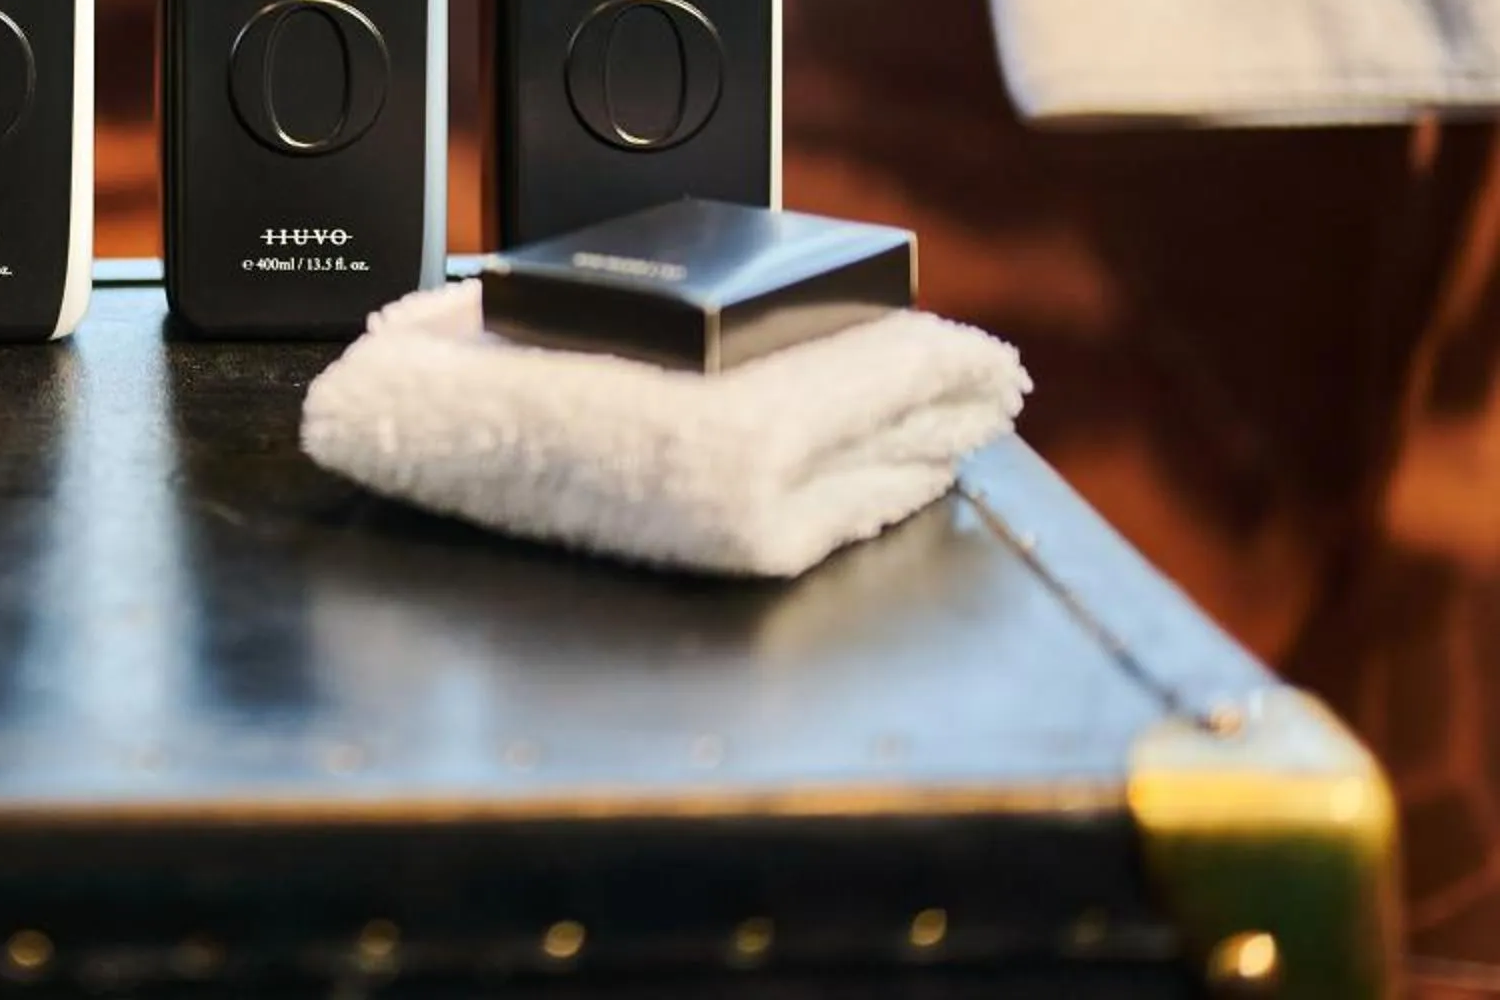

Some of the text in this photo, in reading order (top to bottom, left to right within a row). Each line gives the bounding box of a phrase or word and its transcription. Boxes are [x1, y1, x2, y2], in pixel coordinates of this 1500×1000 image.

[256, 257, 295, 270] 400ml
[307, 258, 332, 270] 13.5
[350, 261, 370, 270] oz.
